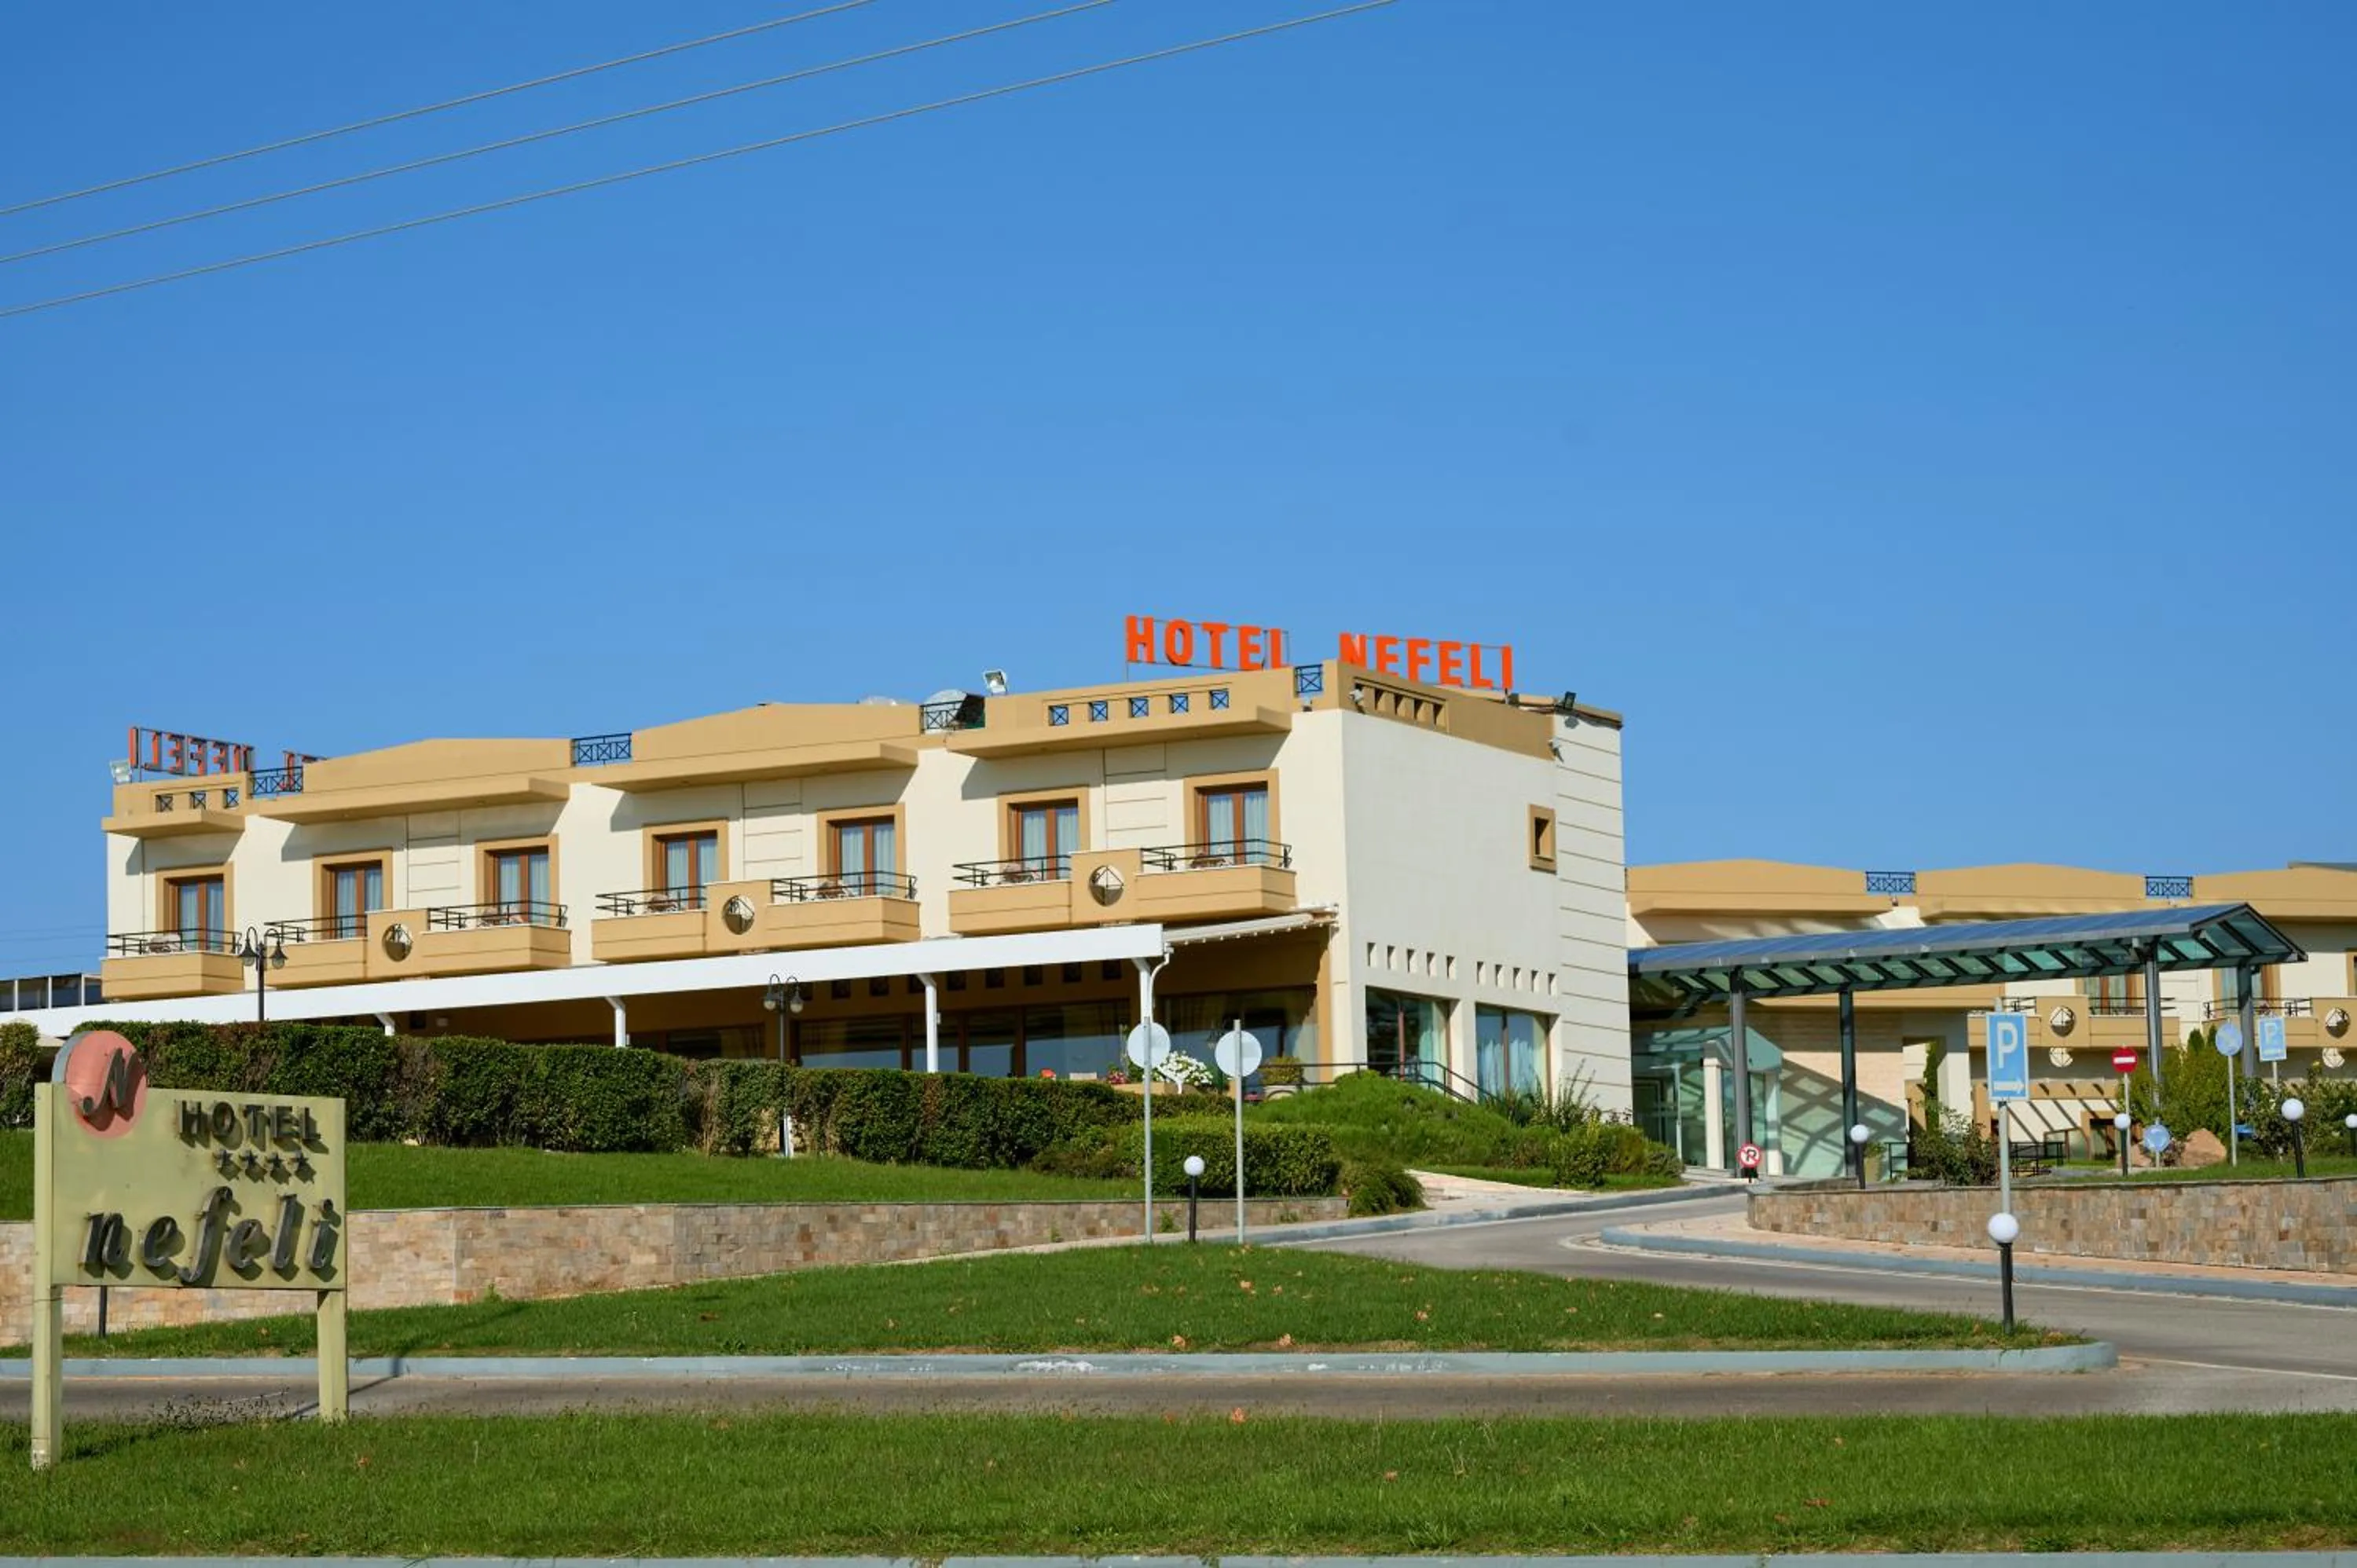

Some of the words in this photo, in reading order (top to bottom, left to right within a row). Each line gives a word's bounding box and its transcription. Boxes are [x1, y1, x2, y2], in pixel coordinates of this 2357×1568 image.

[1126, 615, 1289, 670] HOTEL
[1339, 632, 1512, 689] NEFELI
[1996, 1022, 2018, 1068] P
[2265, 1022, 2278, 1044] P
[179, 1101, 321, 1142] HOTEL
[79, 1186, 336, 1284] nefeli
